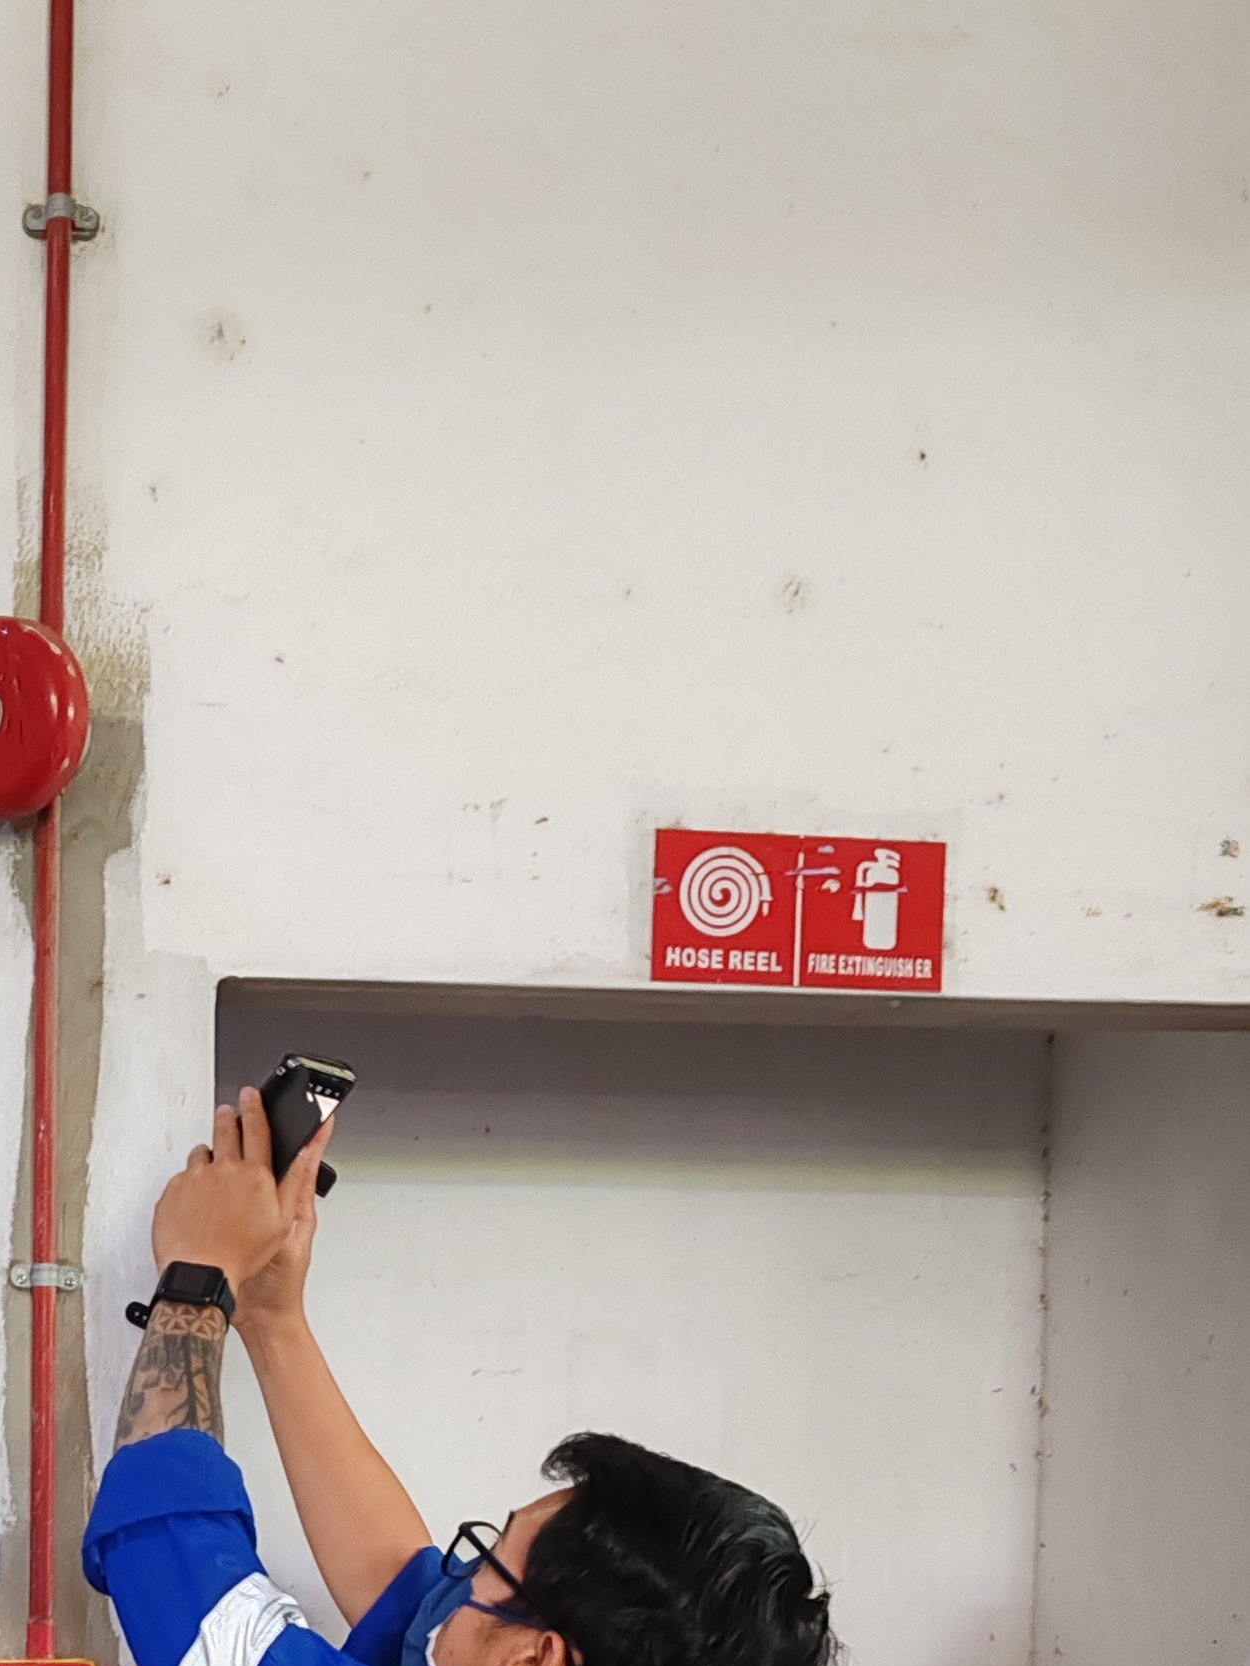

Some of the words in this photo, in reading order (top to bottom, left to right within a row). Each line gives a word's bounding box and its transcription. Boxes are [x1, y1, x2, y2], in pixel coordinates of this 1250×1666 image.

[666, 947, 724, 970] HOSE
[729, 950, 783, 972] REEL
[807, 953, 836, 974] FIRE
[838, 954, 933, 978] EXTINGUISHER
